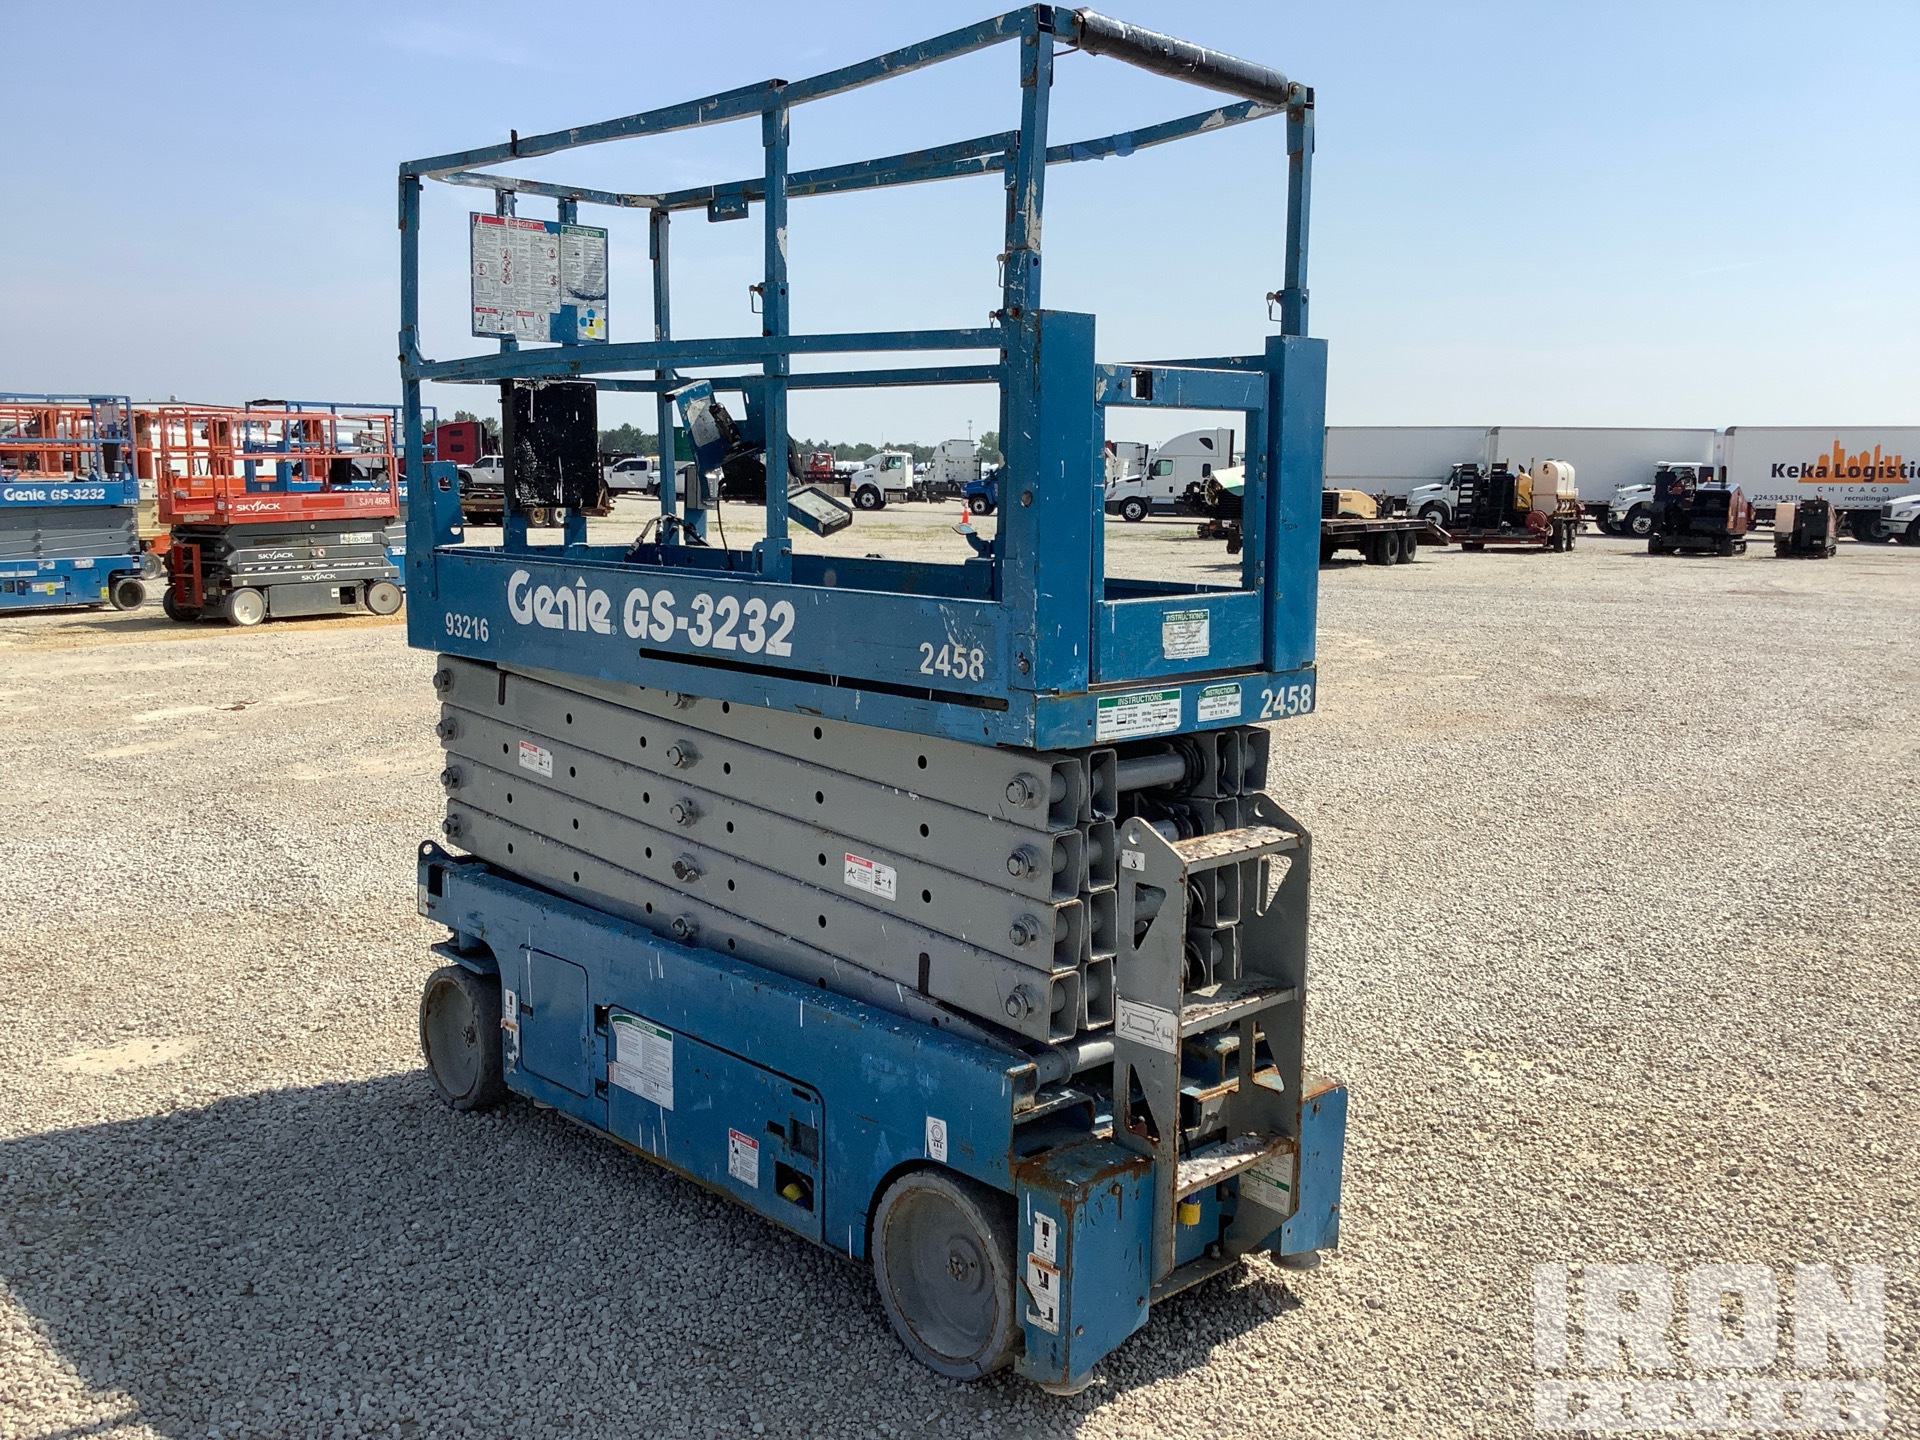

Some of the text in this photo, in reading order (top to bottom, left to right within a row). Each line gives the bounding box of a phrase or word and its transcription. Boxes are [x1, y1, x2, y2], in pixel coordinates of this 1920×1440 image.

[1771, 462, 1828, 479] Keka
[3, 488, 106, 501] Genie GS-3232
[236, 500, 281, 512] SKYJACK
[257, 551, 295, 560] SKYJACK
[301, 572, 337, 581] SKYJACK
[507, 569, 796, 657] Genie GS-3232
[445, 611, 489, 643] 93216
[919, 642, 985, 682] 2458
[1205, 686, 1236, 697] INSTRUCTIONS
[1117, 693, 1163, 705] INSTRUCTIONS
[1259, 684, 1312, 719] 2458
